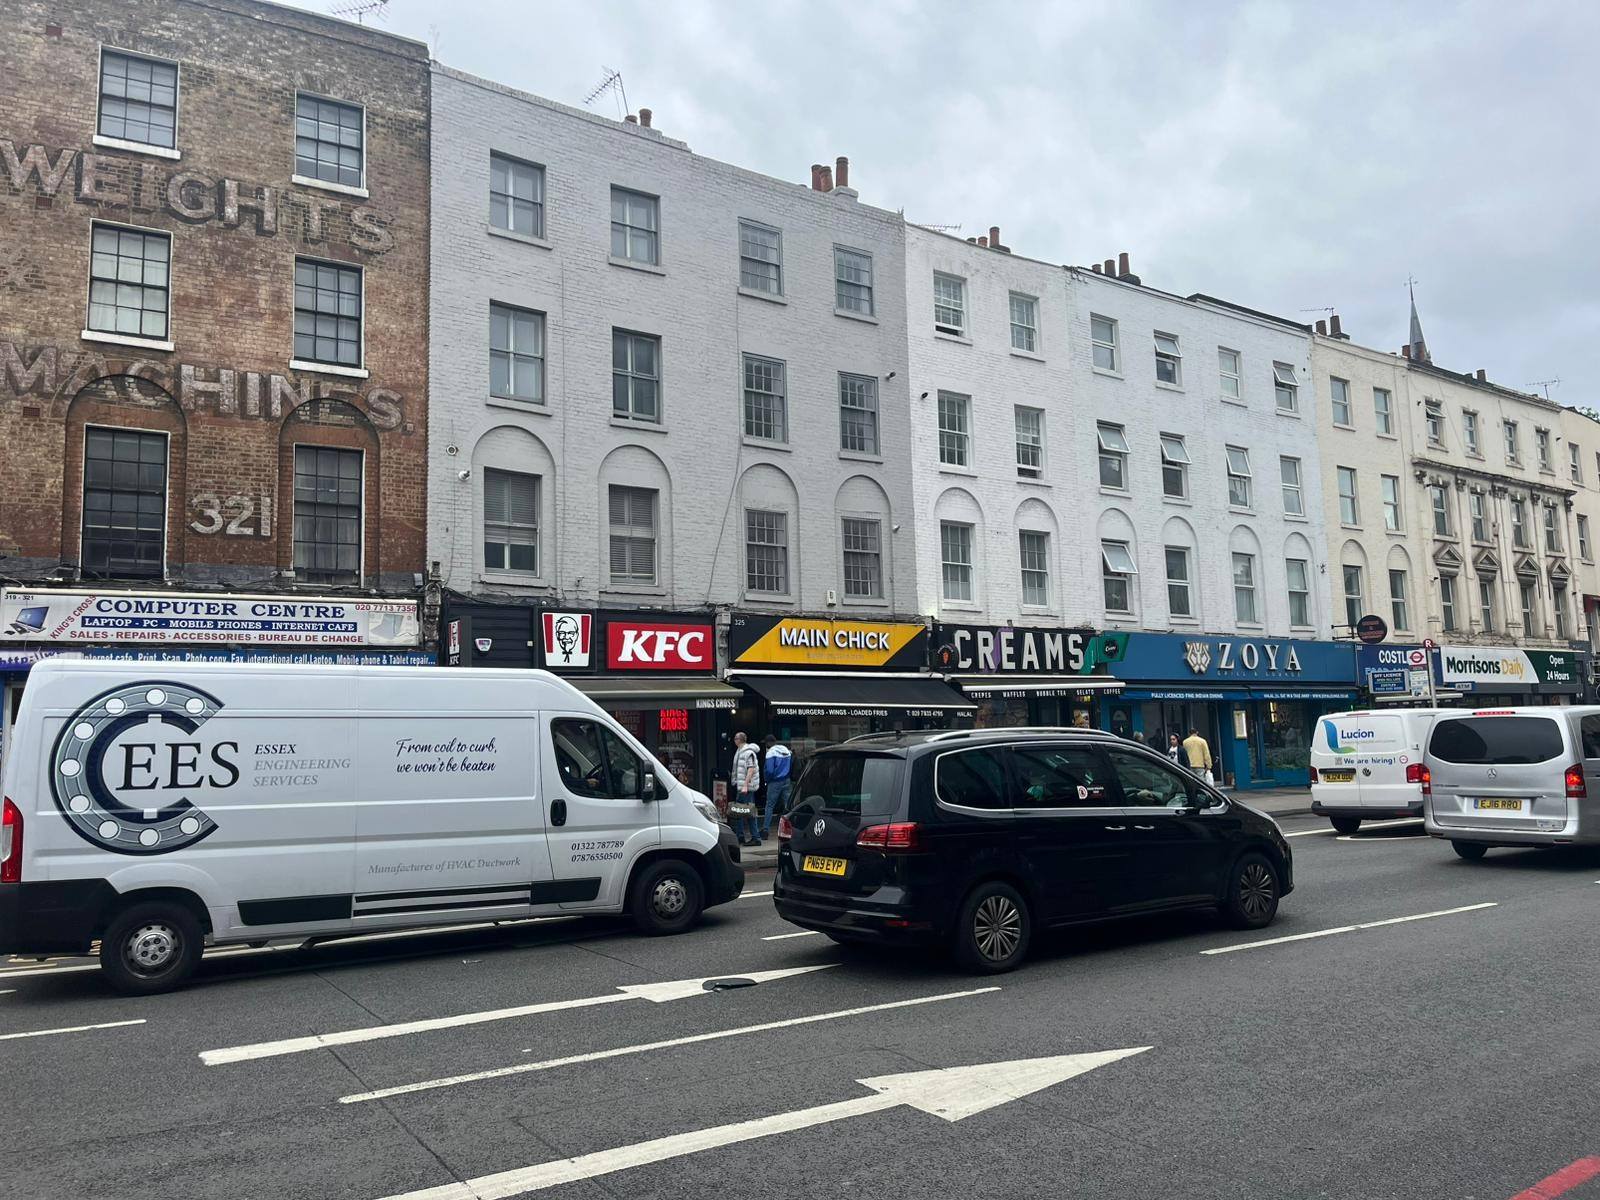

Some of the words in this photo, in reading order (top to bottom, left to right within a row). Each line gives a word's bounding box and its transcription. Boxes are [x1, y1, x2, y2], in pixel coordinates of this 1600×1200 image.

[0, 138, 396, 254] WEIGHTS
[189, 495, 272, 537] 321
[96, 600, 238, 616] COMPUTER
[251, 604, 346, 618] CENTRE
[50, 616, 75, 640] KING'S
[74, 594, 98, 618] CROSS
[85, 618, 132, 627] LAPTOP
[143, 620, 158, 628] PC
[169, 620, 214, 629] MOBILE
[217, 622, 262, 630] PHONES
[272, 622, 324, 630] INTERNET
[70, 631, 108, 639] SALES
[116, 632, 166, 640] REPAIRS
[174, 632, 251, 641] ACCESSORIES
[780, 627, 830, 648] MAIN
[834, 630, 890, 650] CHICK
[618, 630, 704, 663] KFC
[954, 630, 1084, 670] CREAMS
[336, 655, 358, 664] Mobile
[361, 656, 380, 666] phone
[382, 656, 388, 664] &
[389, 655, 408, 665] Tablet
[449, 654, 460, 666] KFC
[1216, 642, 1302, 671] ZOYA
[1378, 650, 1408, 664] COSTL
[1550, 655, 1564, 667] Open
[1446, 654, 1500, 674] Morrisons
[1502, 657, 1524, 680] Daily
[1546, 670, 1554, 680] 24
[1554, 671, 1570, 680] Hours
[696, 699, 715, 708] KINGS
[716, 699, 736, 708] CROSS
[660, 717, 688, 730] CROSS
[1341, 729, 1374, 739] Lucion
[254, 744, 296, 755] ESSEX
[396, 738, 434, 757] From
[434, 738, 456, 754] coil
[456, 741, 468, 753] to
[468, 737, 497, 754] curb,
[116, 741, 240, 790] EES
[254, 758, 351, 771] ENGINEERING
[396, 761, 412, 773] we
[414, 756, 444, 772] won't
[446, 757, 458, 772] be
[460, 756, 496, 772] beaten
[1372, 757, 1396, 765] hiring!
[253, 774, 319, 787] SERVICES
[1480, 800, 1498, 808] EJ16
[1501, 800, 1518, 808] RRO
[571, 842, 595, 851] 01322
[596, 840, 624, 850] 787789
[571, 852, 623, 863] 07876550500
[806, 856, 824, 870] PN69
[826, 860, 843, 872] EYP
[435, 860, 446, 873] of
[448, 860, 476, 870] HVAC
[476, 857, 521, 870] Ductwork
